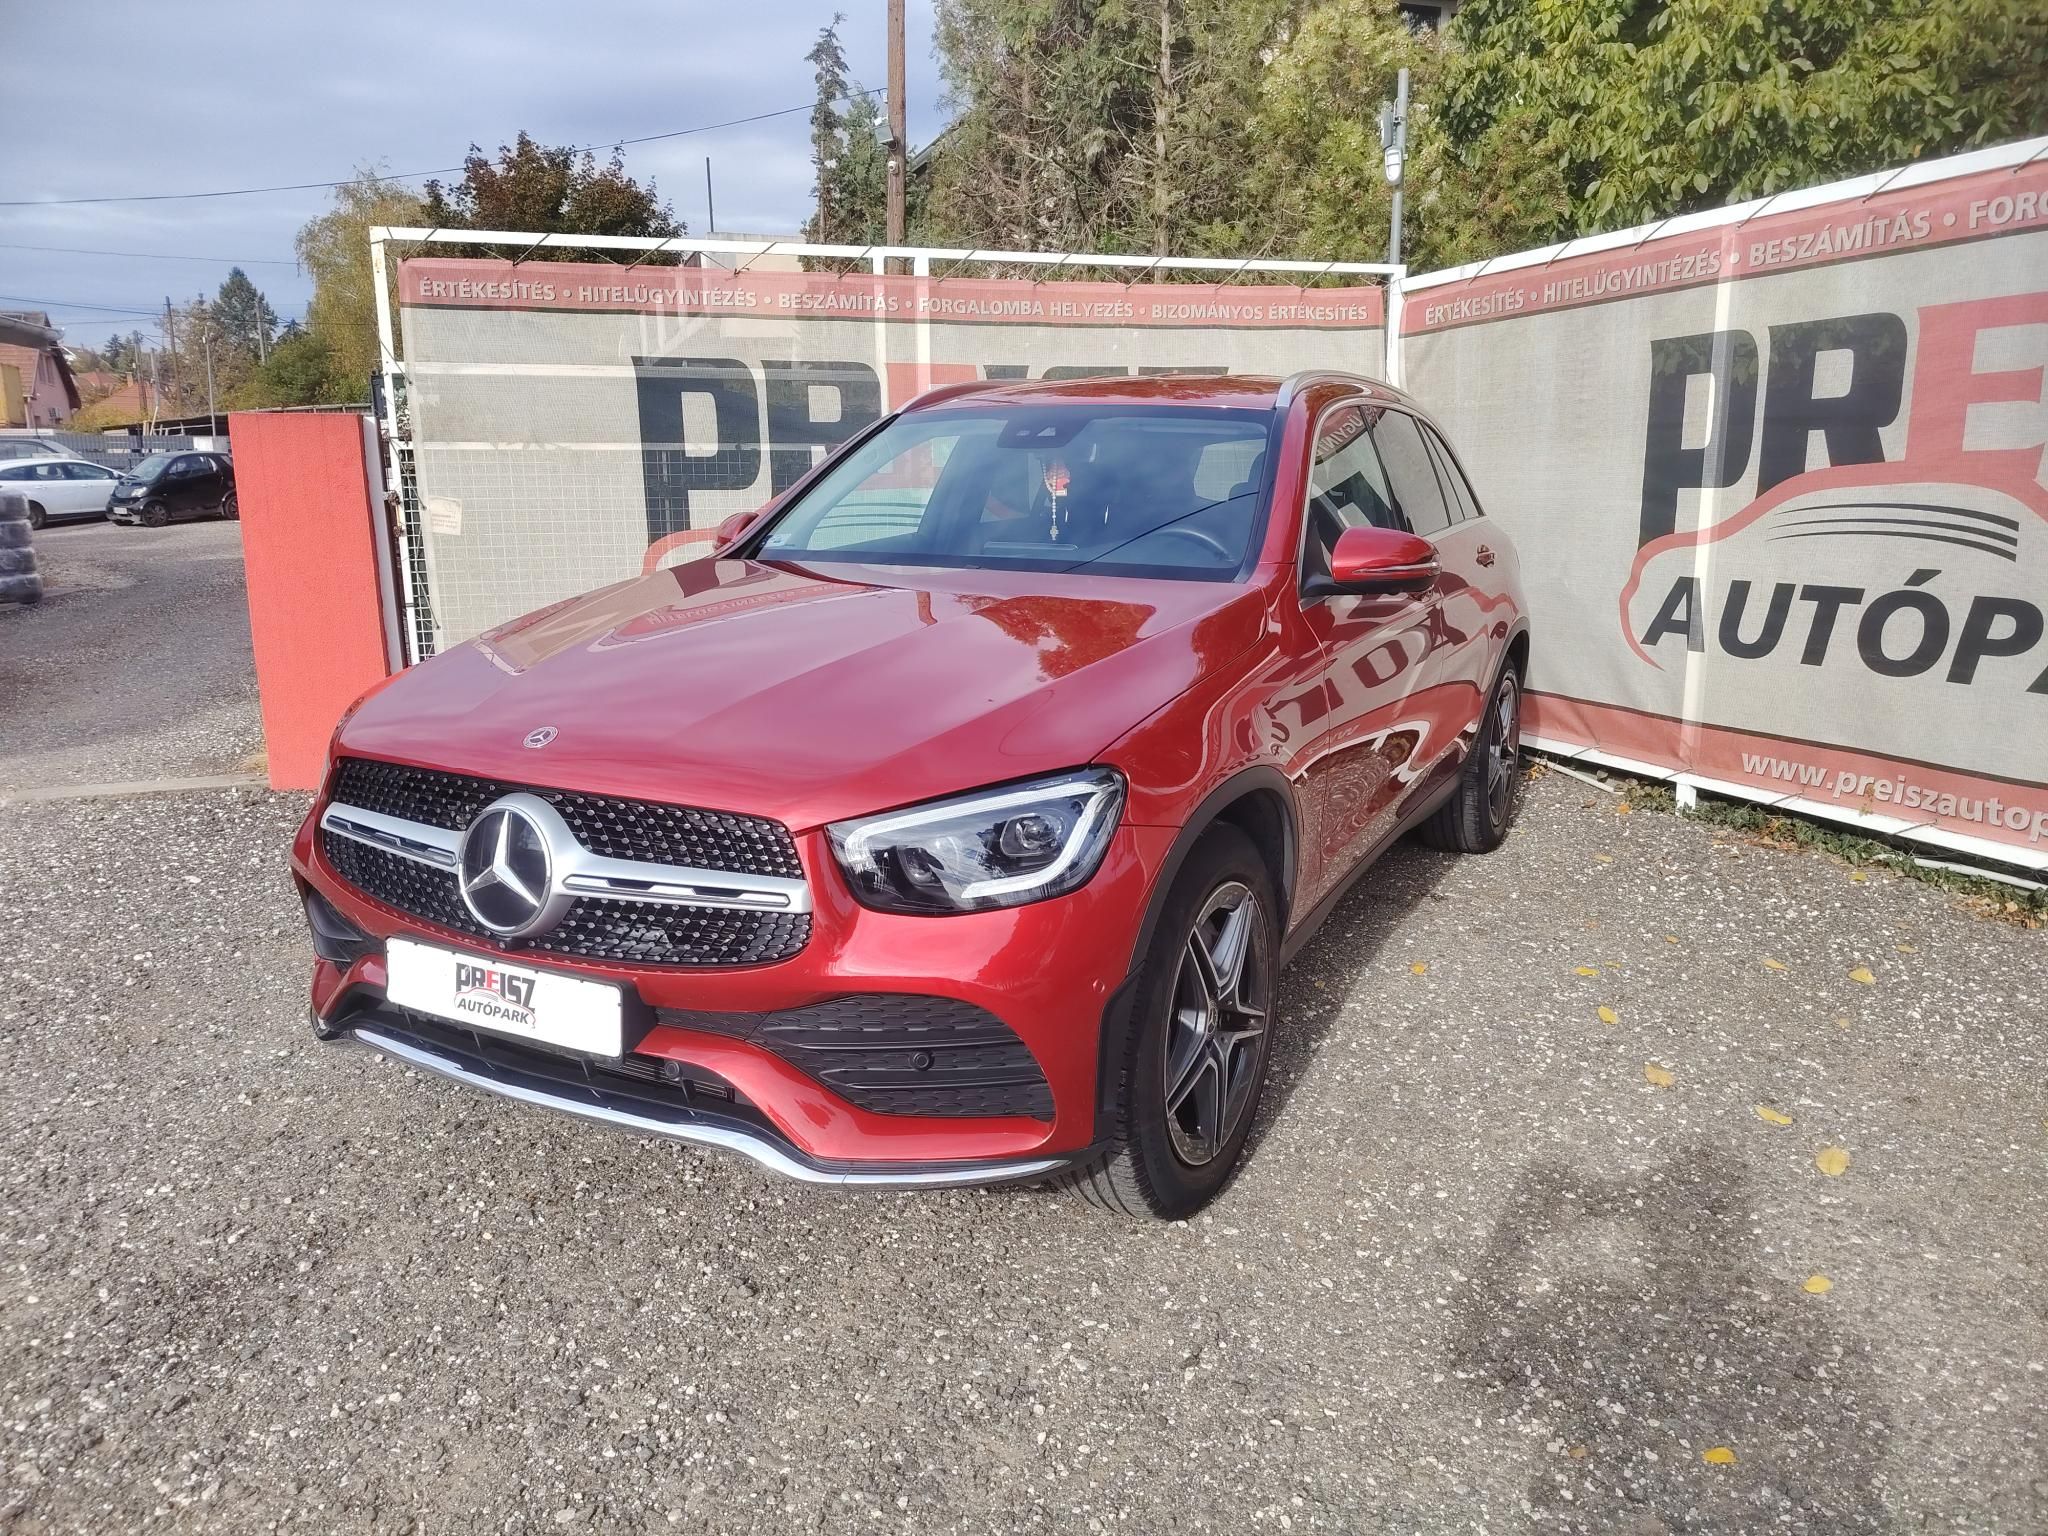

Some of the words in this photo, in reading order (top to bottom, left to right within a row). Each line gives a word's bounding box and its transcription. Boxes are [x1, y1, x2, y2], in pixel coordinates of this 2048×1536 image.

[1424, 286, 1526, 326] ÉRTÉKESÍTÉS
[1543, 250, 1723, 305] HITELÜGYINTÉZÉS
[1749, 209, 1933, 267] BESZÁMÍTÁS
[419, 277, 557, 301] ÉRTÉKESÍTÉS
[578, 283, 757, 308] HITELÜGYINTÉZÉS
[778, 291, 900, 312] BESZÁMÍTÁS
[919, 297, 1045, 316] FORGALOMBA
[1050, 299, 1135, 318] HELYEZÉS
[1151, 301, 1264, 321] BIZOMÁNYOS
[1268, 302, 1369, 321] ÉRTÉKESÍTÉS
[455, 962, 536, 1014] PREISZ
[457, 997, 529, 1025] AUTÓPARK
